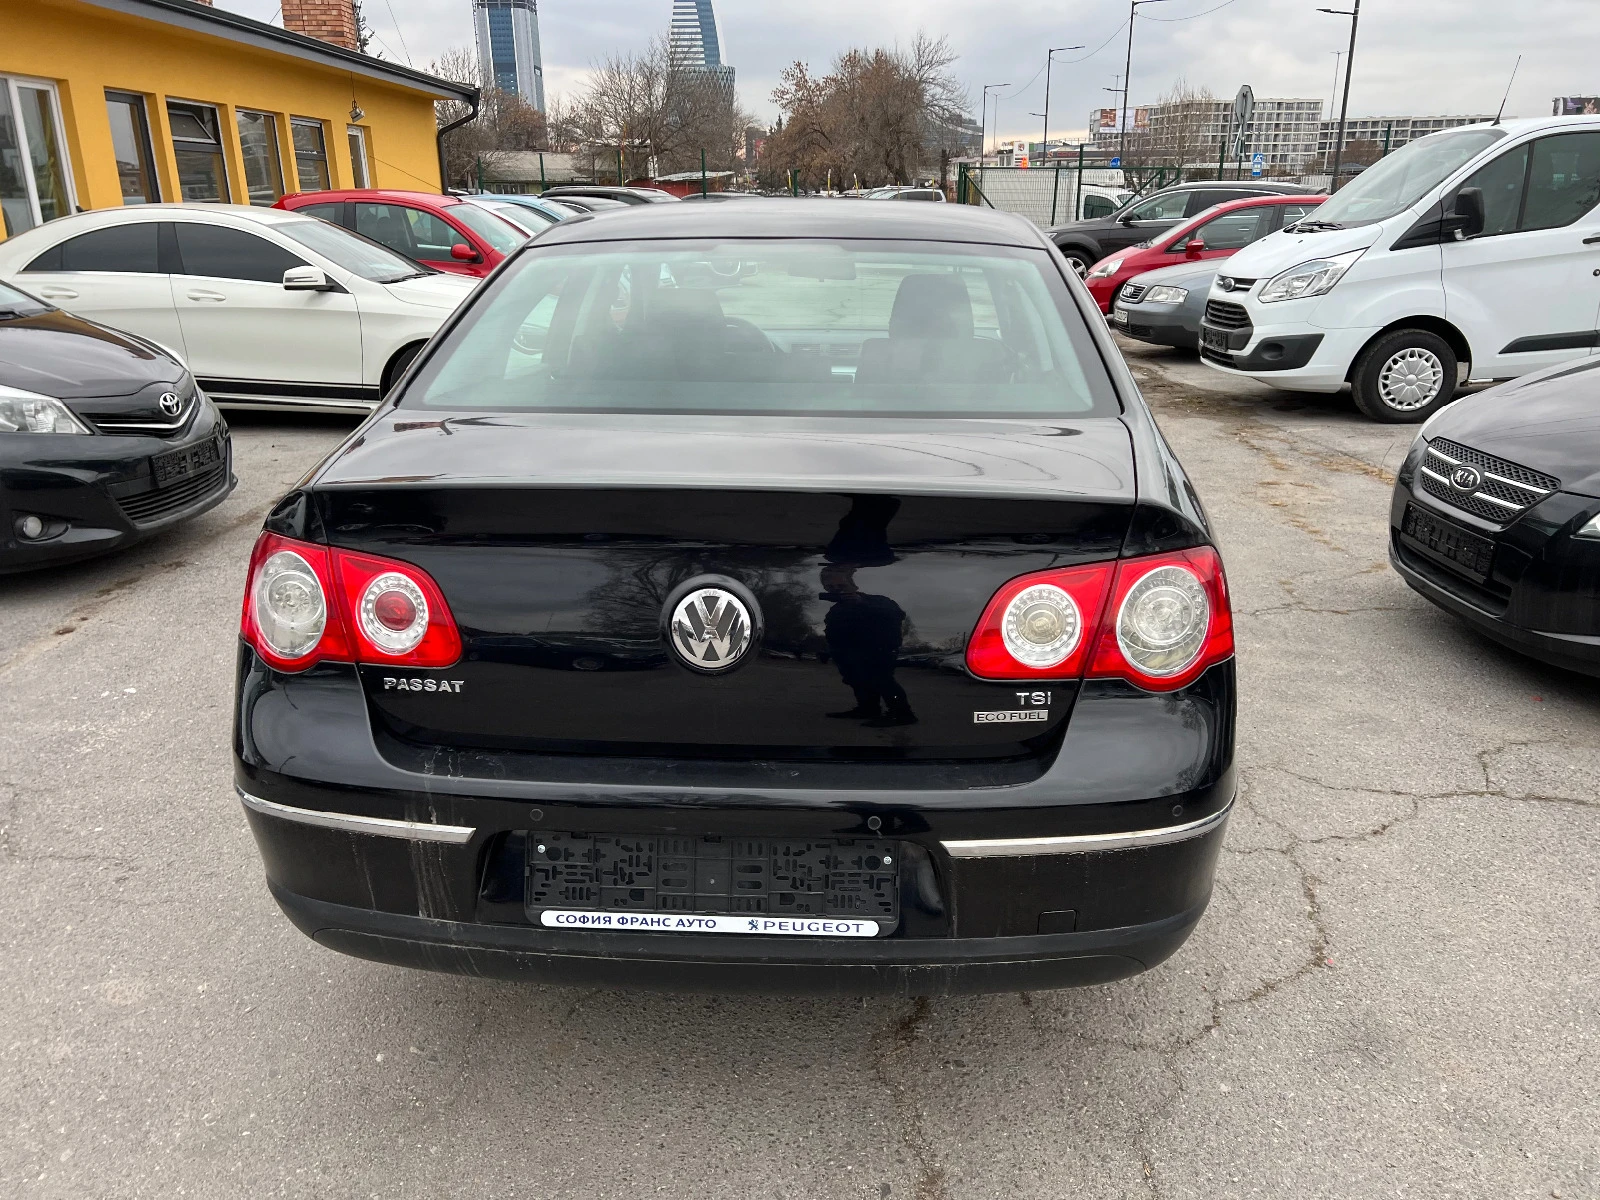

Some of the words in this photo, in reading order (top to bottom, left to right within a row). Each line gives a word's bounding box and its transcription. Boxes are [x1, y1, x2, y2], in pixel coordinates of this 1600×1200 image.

[1455, 470, 1474, 487] KIA
[671, 588, 752, 669] VW
[383, 677, 465, 693] PASSAT
[1016, 691, 1052, 705] TSI
[555, 914, 612, 925] СОФИЯ
[616, 916, 672, 928] ФРАНС
[675, 917, 717, 929] АУТО
[763, 920, 865, 933] PEUGEOT
